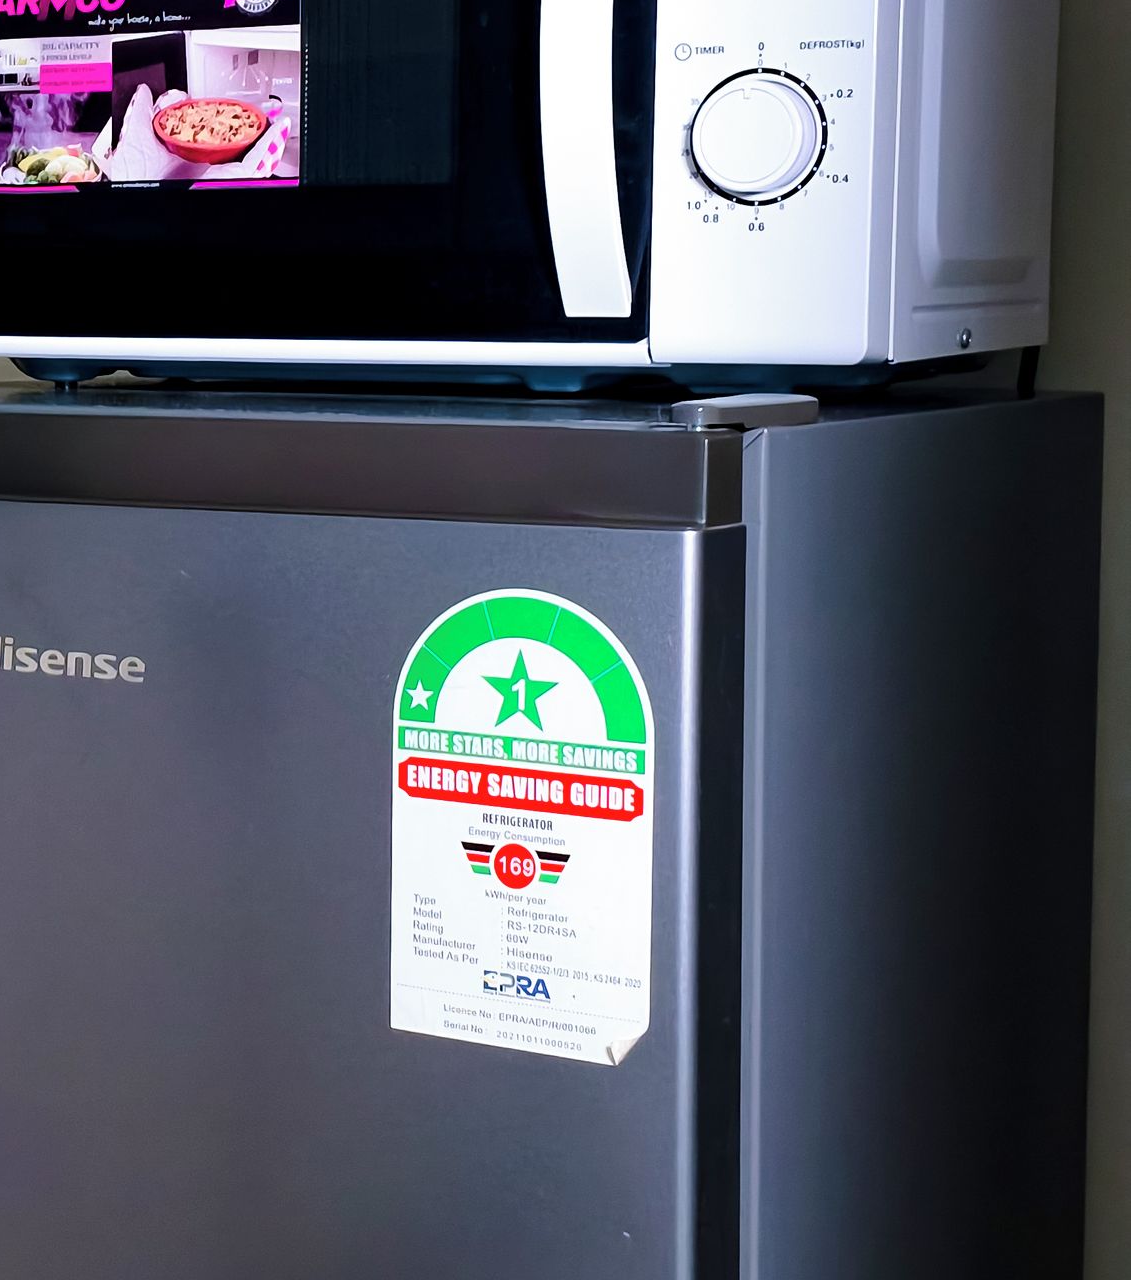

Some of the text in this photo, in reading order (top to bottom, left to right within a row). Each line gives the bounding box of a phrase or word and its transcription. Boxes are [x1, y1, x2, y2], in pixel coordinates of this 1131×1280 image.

[695, 46, 725, 55] TIMER
[758, 42, 765, 51] 0
[836, 89, 854, 99] 0.2
[832, 174, 849, 183] 0.4
[687, 201, 701, 210] 1.0
[726, 203, 736, 211] 10
[703, 214, 719, 223] 0.8
[748, 222, 765, 232] 0.6
[511, 678, 526, 712] 1
[404, 729, 638, 772] MORE STARS, MORE SAVINGS
[407, 764, 635, 812] ENERGY SAVING GUIDE
[482, 813, 553, 831] REFRIGERATOR
[468, 826, 566, 847] Energy Consumption
[499, 856, 535, 877] 169
[413, 893, 436, 906] Type
[526, 896, 547, 905] year
[413, 906, 442, 920] Model
[413, 919, 444, 935] Rating
[413, 933, 476, 951] Manufacturer
[413, 946, 444, 960] Tested
[446, 951, 459, 962] As
[462, 953, 479, 965] Per
[483, 970, 551, 999] EPRA
[443, 1020, 469, 1032] Serial
